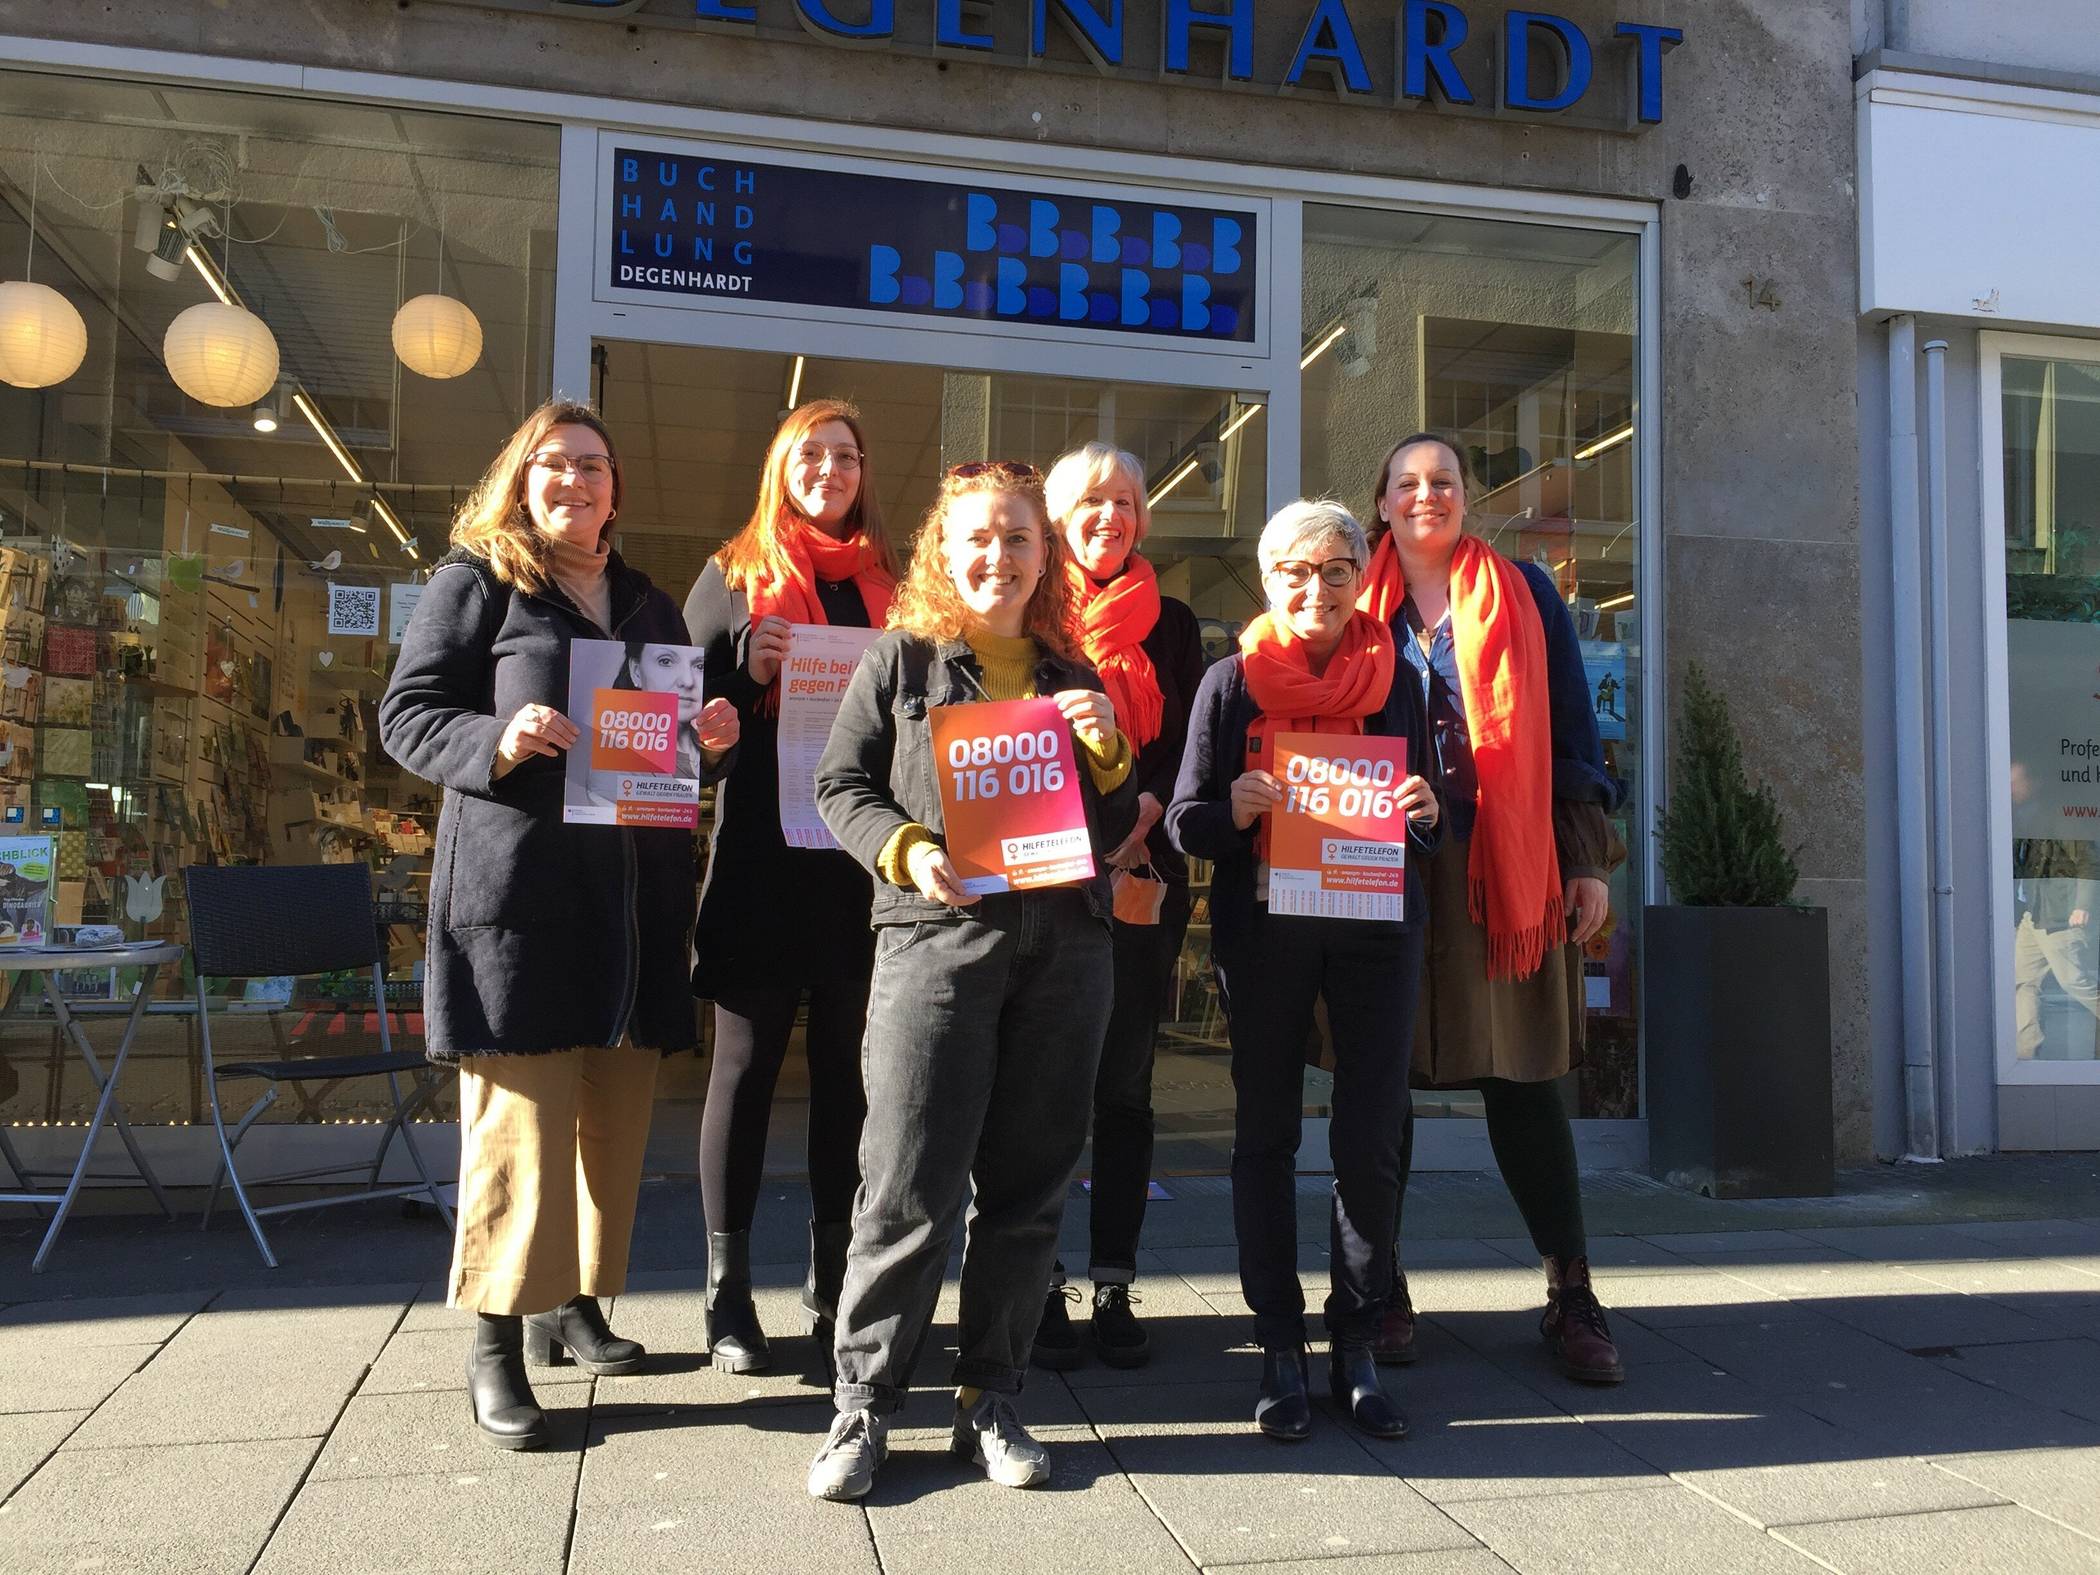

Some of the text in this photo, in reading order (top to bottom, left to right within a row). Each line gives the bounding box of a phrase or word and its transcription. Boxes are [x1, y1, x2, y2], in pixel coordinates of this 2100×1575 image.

[623, 158, 754, 194] BUCH
[622, 194, 754, 229] HAND
[621, 229, 753, 265] LUNG
[620, 265, 753, 292] DEGENHARDT
[1743, 278, 1781, 312] 14
[790, 657, 827, 675] Hilfe
[829, 659, 853, 675] bei
[788, 678, 850, 695] gegen F
[600, 710, 671, 733] 08000
[600, 729, 668, 752] 116 016
[949, 730, 1059, 768] 08000
[2061, 738, 2100, 760] Profe
[953, 761, 1065, 801] 116 016
[1286, 755, 1394, 788] 08000
[2061, 765, 2091, 783] und
[636, 781, 694, 792] HILFETELEFON
[1286, 785, 1394, 819] 116 016
[621, 813, 693, 823] www.hilfetelefon.de
[0, 847, 48, 860] HBLICK
[1341, 846, 1399, 856] HILFETELEFON
[1327, 876, 1399, 888] www.hilfetelefon.de
